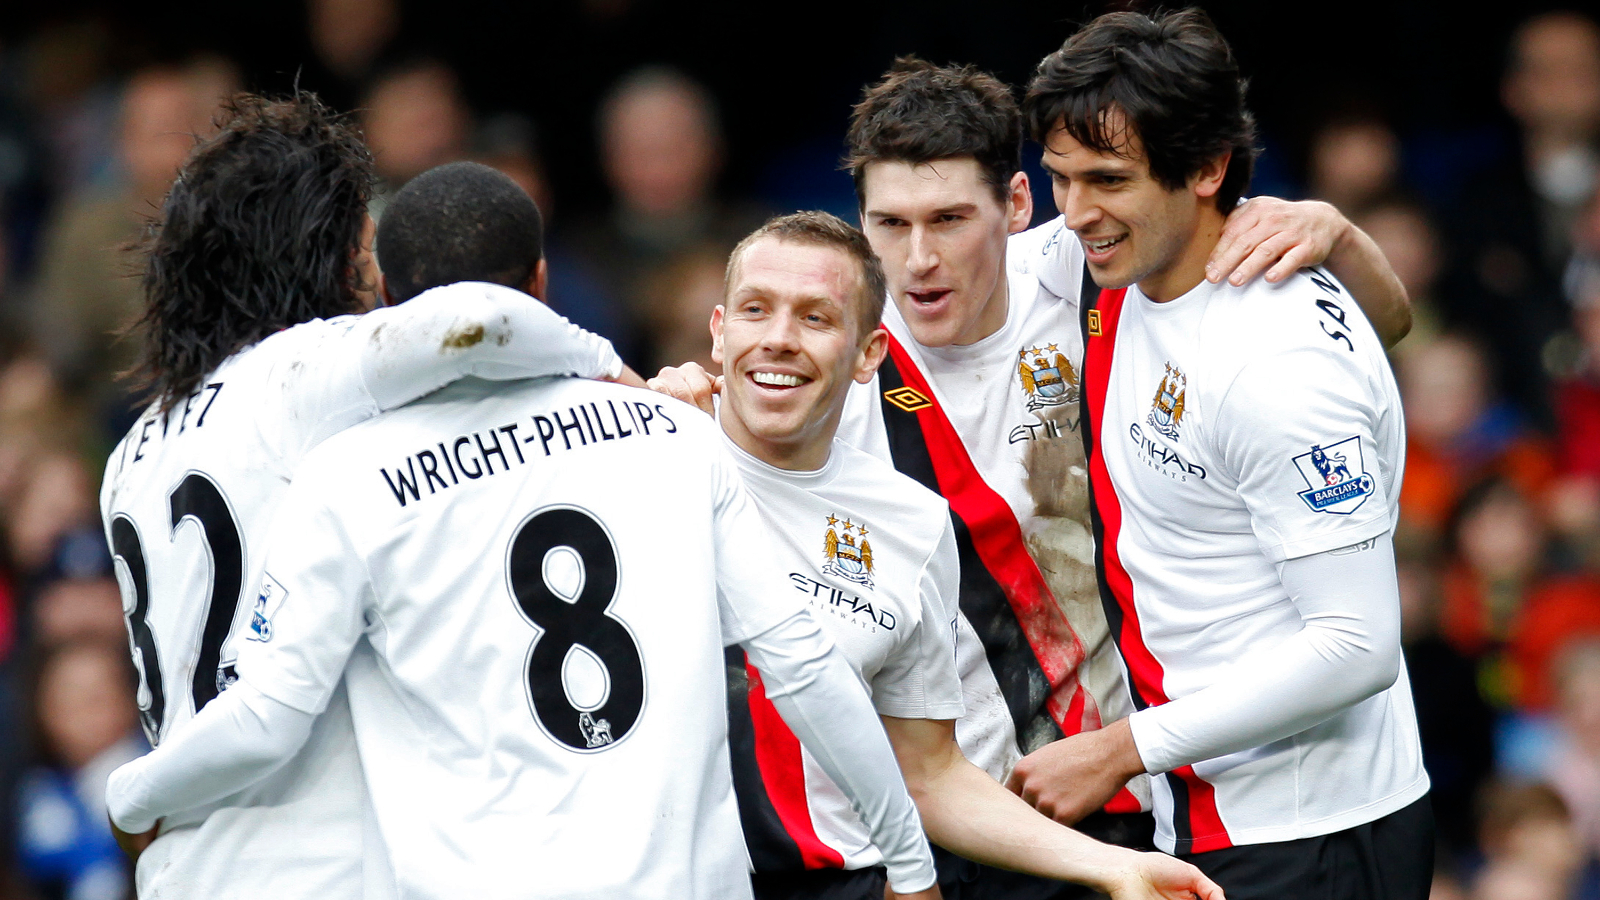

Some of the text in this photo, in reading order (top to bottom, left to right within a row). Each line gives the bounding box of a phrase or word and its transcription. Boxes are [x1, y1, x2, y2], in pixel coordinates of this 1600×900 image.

[379, 399, 677, 507] WRIGHT-PHILLIPS
[1129, 422, 1207, 480] ETIHAD
[1137, 451, 1187, 482] AIRWAYS
[1314, 480, 1358, 502] BARCLAYS
[505, 503, 648, 755] 8
[788, 572, 896, 631] ETIHAD
[808, 600, 876, 634] AIRWAYS
